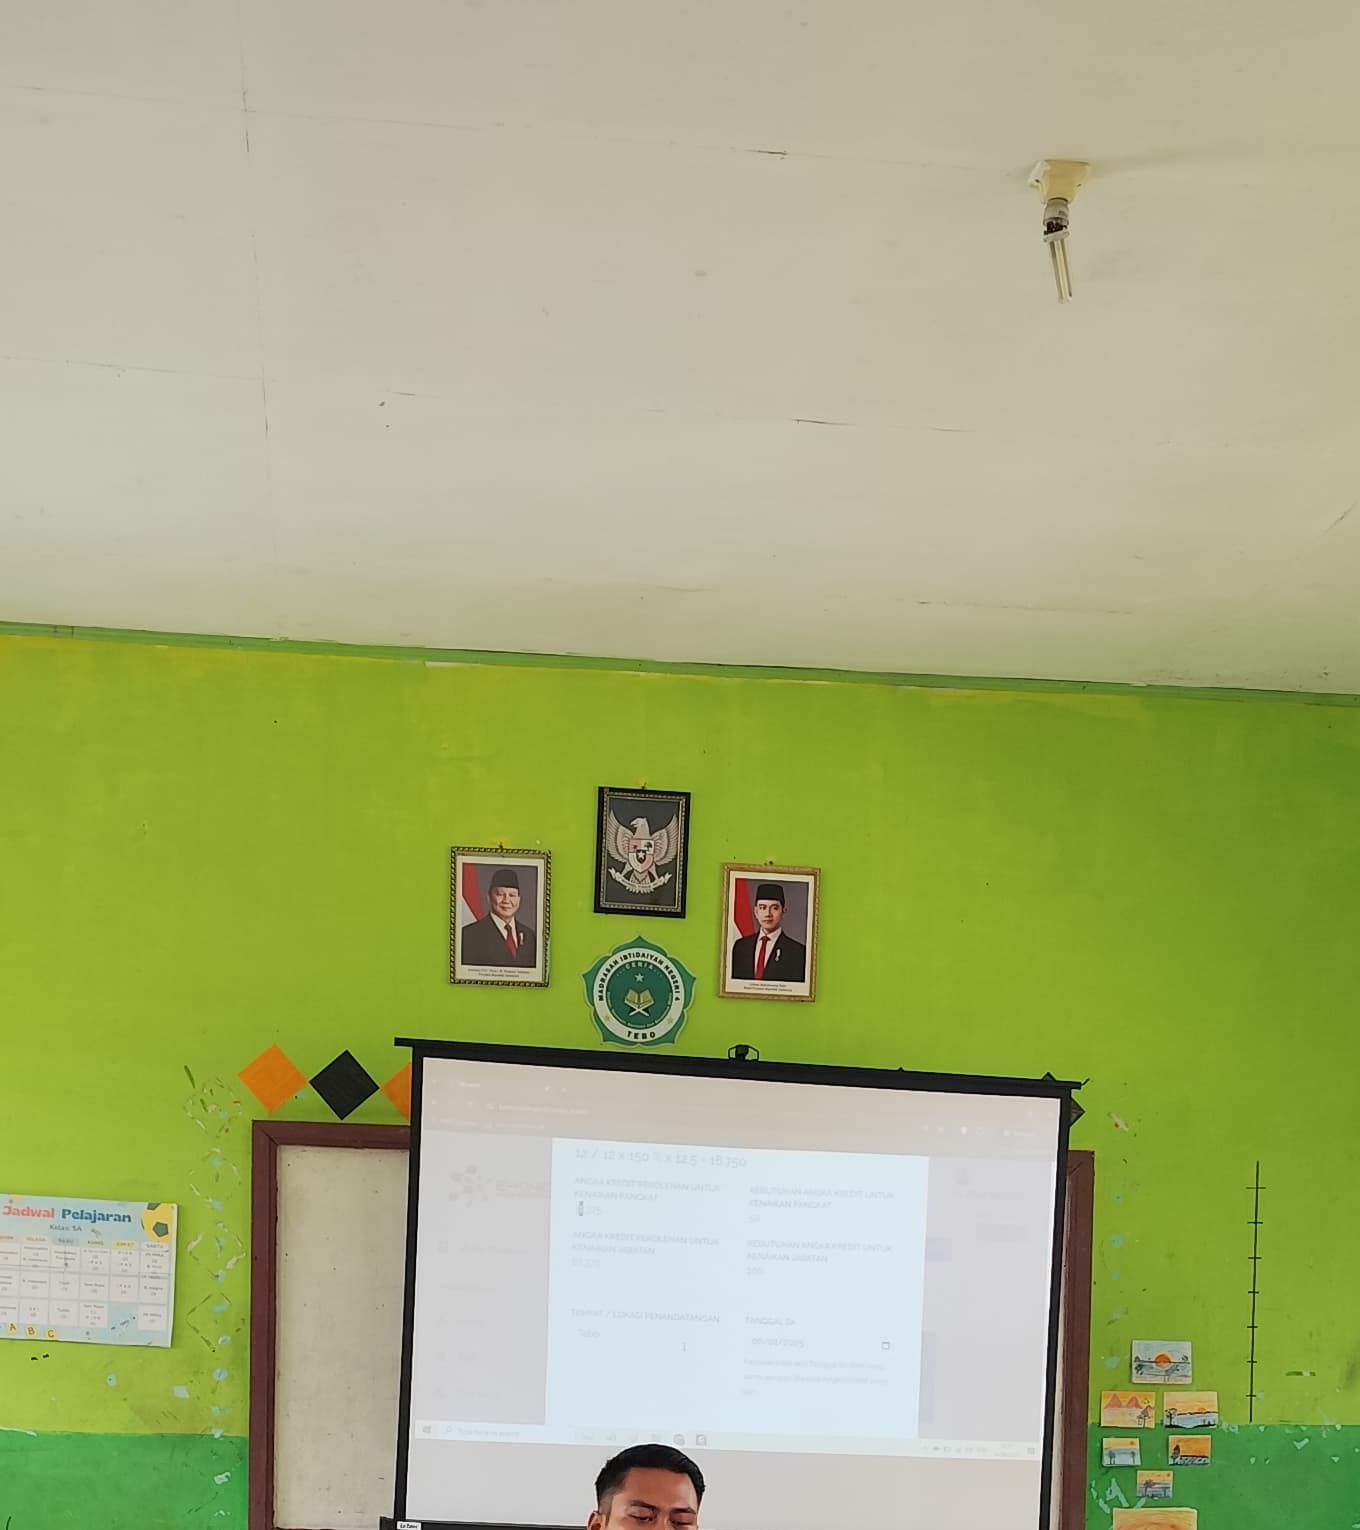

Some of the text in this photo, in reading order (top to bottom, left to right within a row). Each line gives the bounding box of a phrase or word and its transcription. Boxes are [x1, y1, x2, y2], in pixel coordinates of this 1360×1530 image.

[597, 959, 619, 1001] MADRASAH
[620, 951, 664, 965] IBTIDAIYAH
[664, 965, 681, 995] NEGERI
[626, 1031, 657, 1040] TEBO
[2, 1205, 133, 1223] Jadwal Pelajaran
